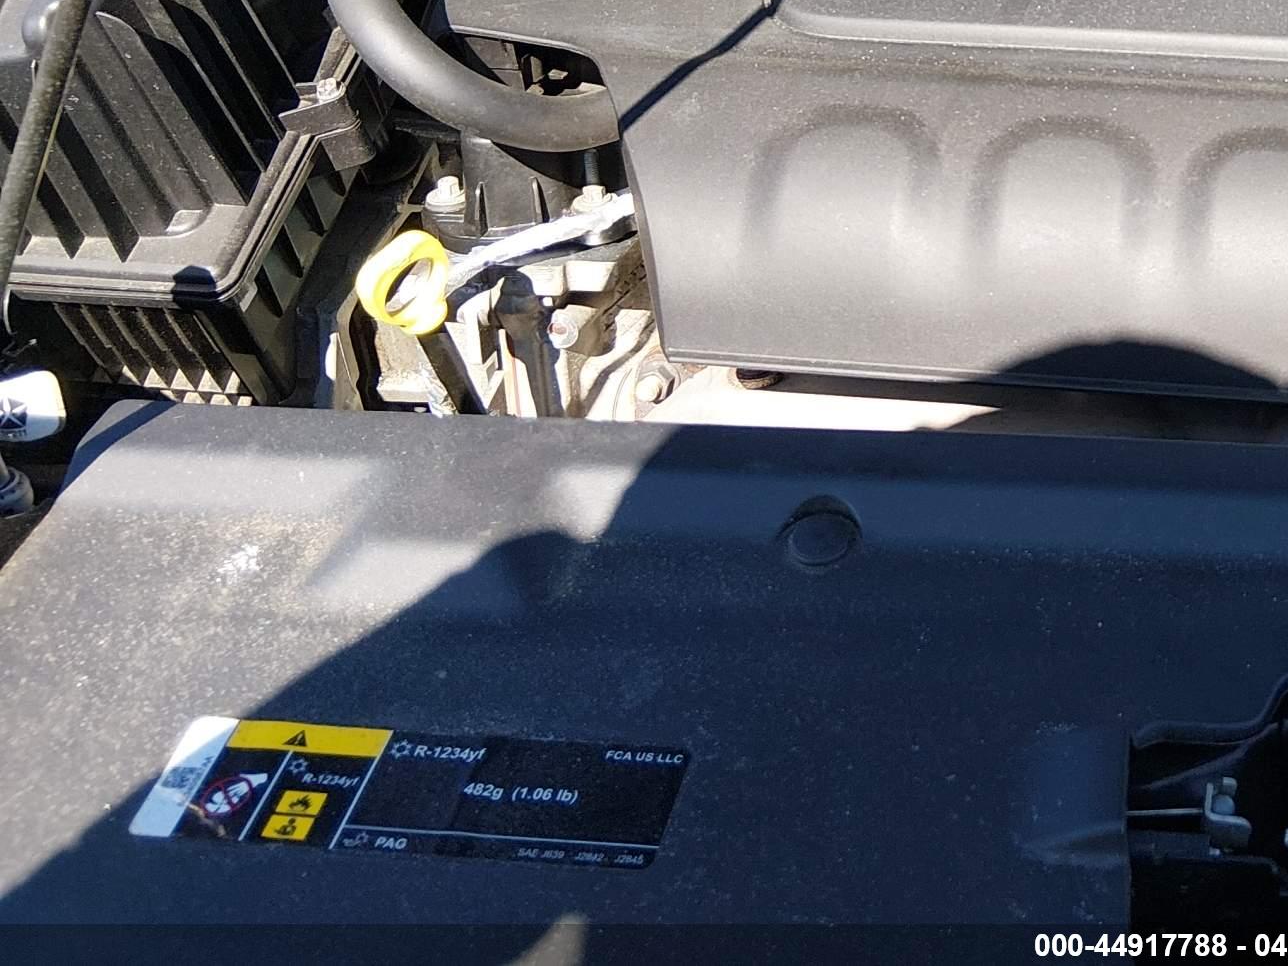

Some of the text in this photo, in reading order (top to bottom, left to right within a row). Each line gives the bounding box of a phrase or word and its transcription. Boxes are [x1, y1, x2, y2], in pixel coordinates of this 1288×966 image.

[414, 744, 487, 763] R-1234yf
[605, 750, 684, 764] FCA US LLC
[303, 772, 361, 788] R-1234yf
[463, 782, 579, 805] 482g (1.06 lb)
